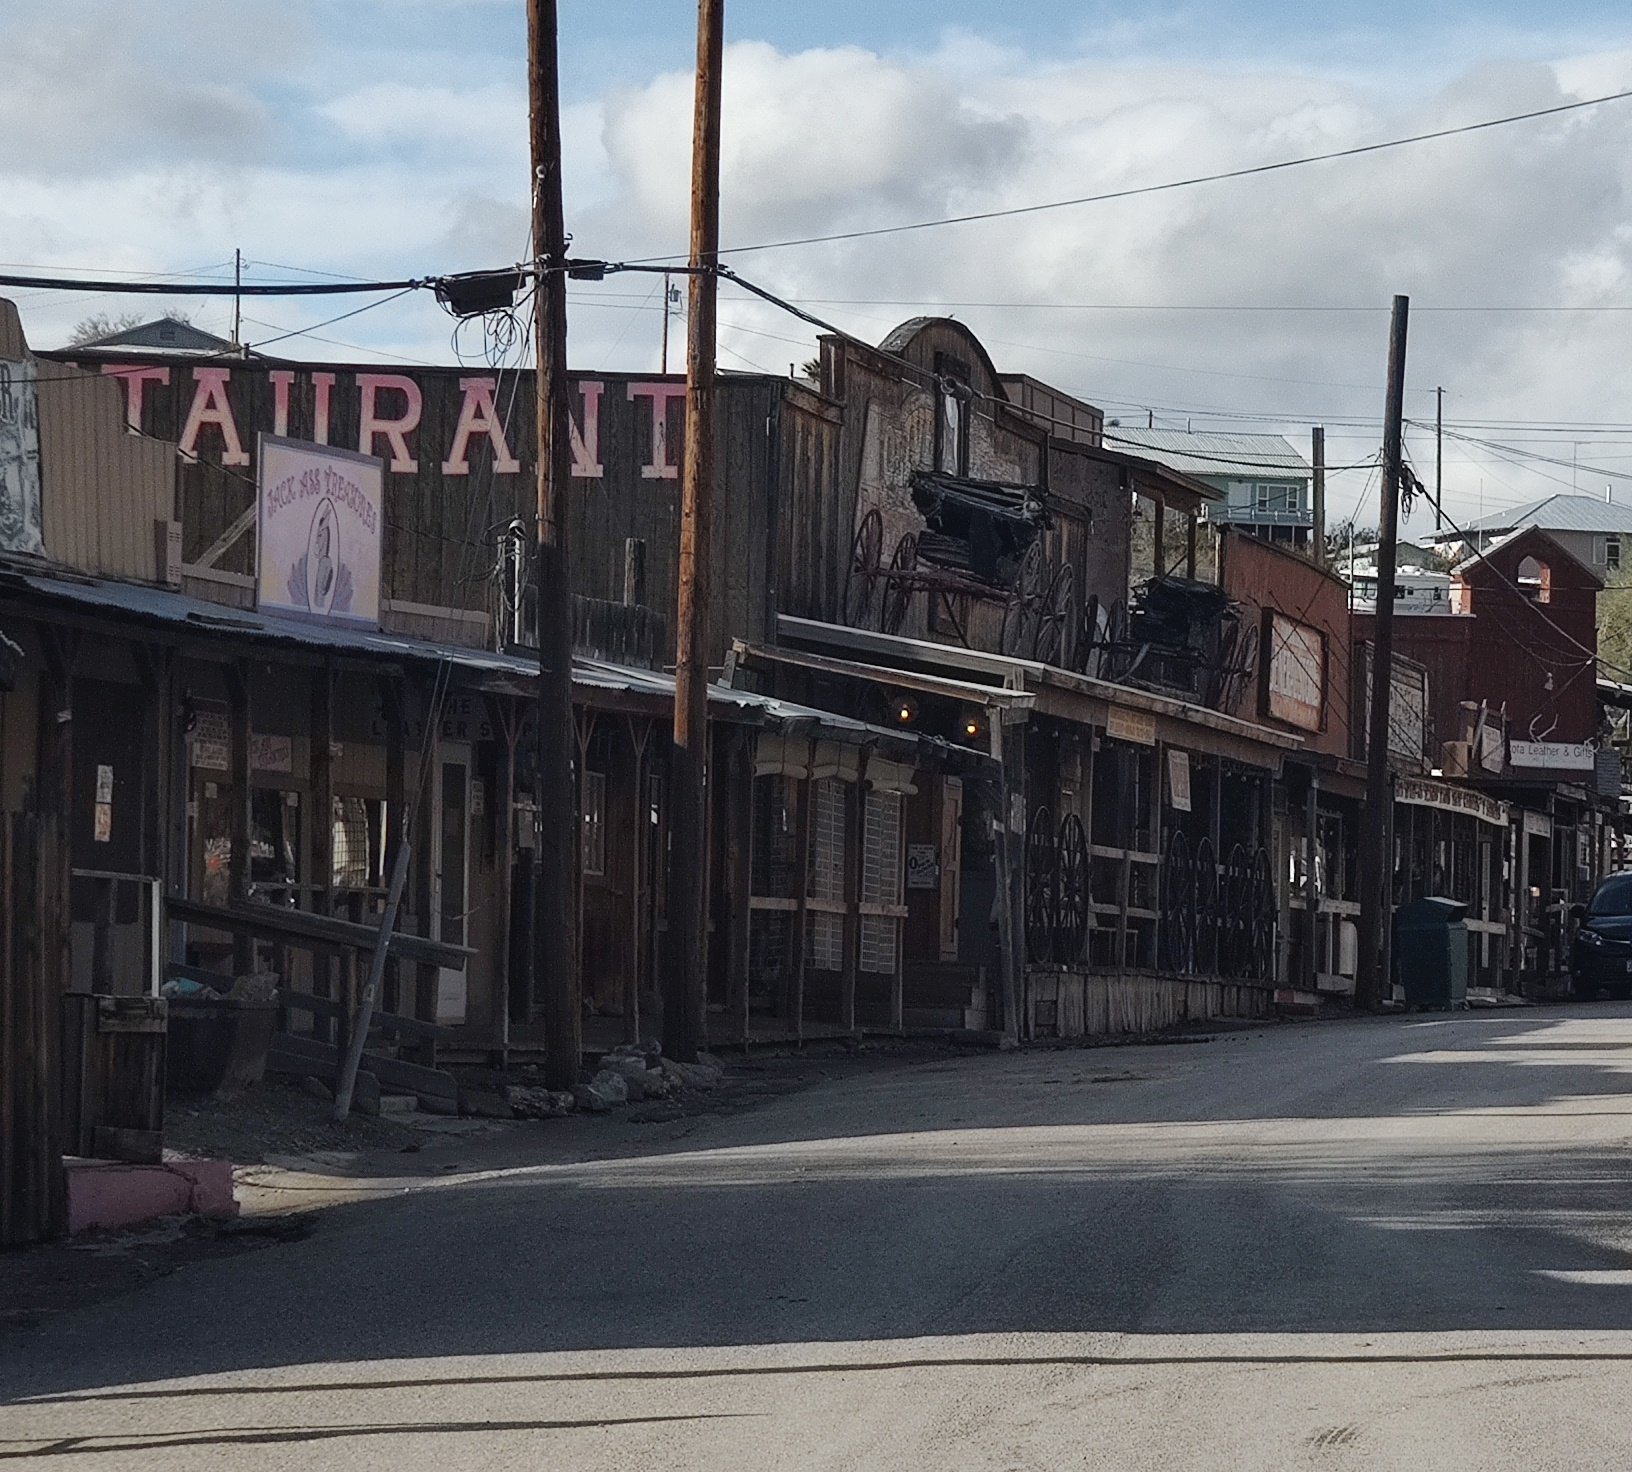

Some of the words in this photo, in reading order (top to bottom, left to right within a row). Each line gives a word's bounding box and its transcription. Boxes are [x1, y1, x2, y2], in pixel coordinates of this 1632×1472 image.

[100, 364, 688, 479] TAURANT
[1528, 744, 1560, 757] Leather
[1573, 746, 1593, 758] Gifts
